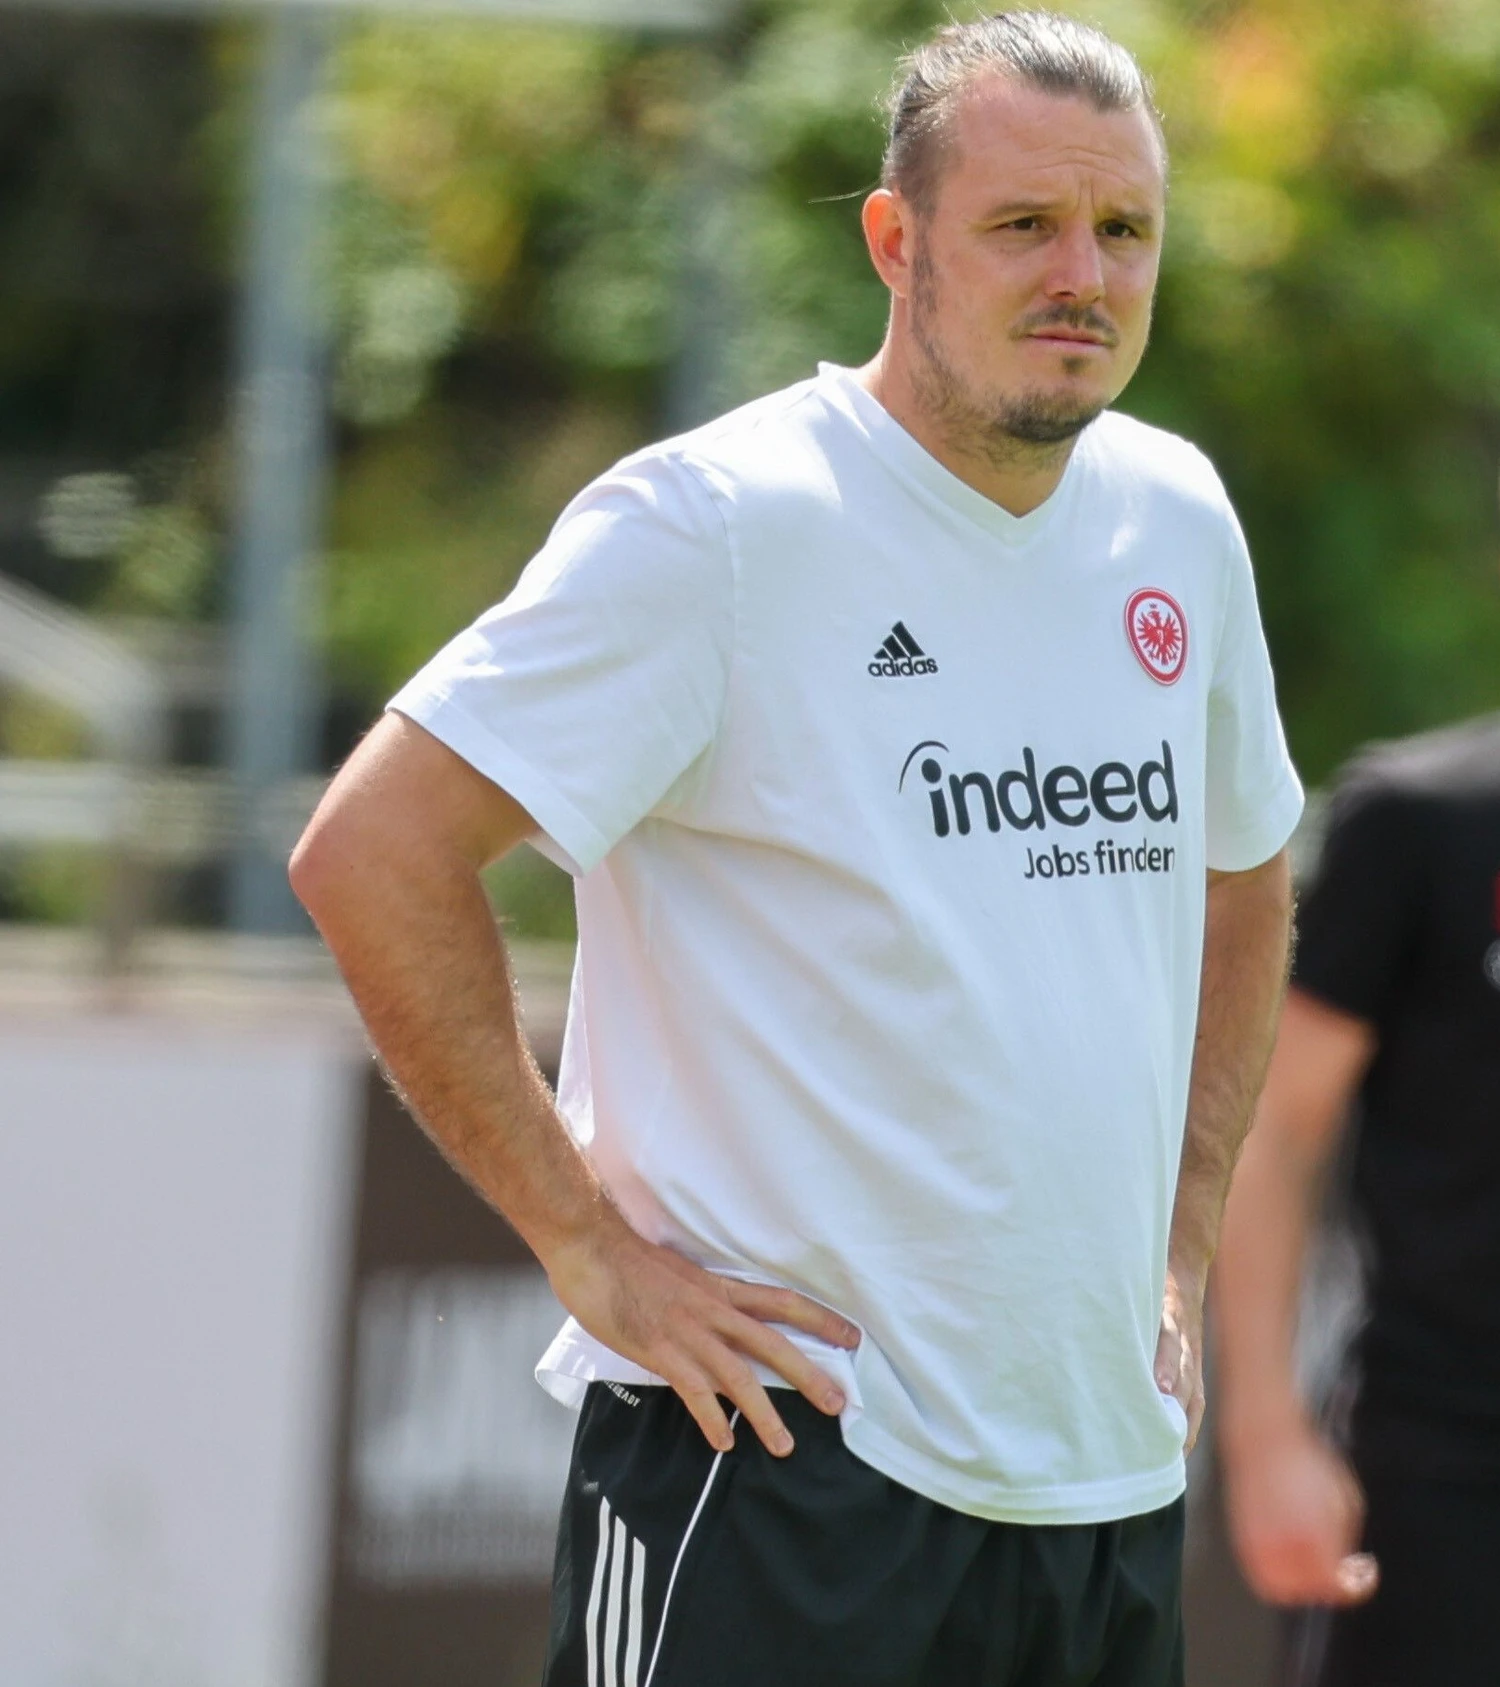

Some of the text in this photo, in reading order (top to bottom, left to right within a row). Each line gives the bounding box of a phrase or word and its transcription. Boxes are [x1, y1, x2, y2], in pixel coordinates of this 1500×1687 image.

[868, 655, 939, 677] adidas
[900, 739, 1179, 838] indeed
[1024, 844, 1091, 879] Jobs
